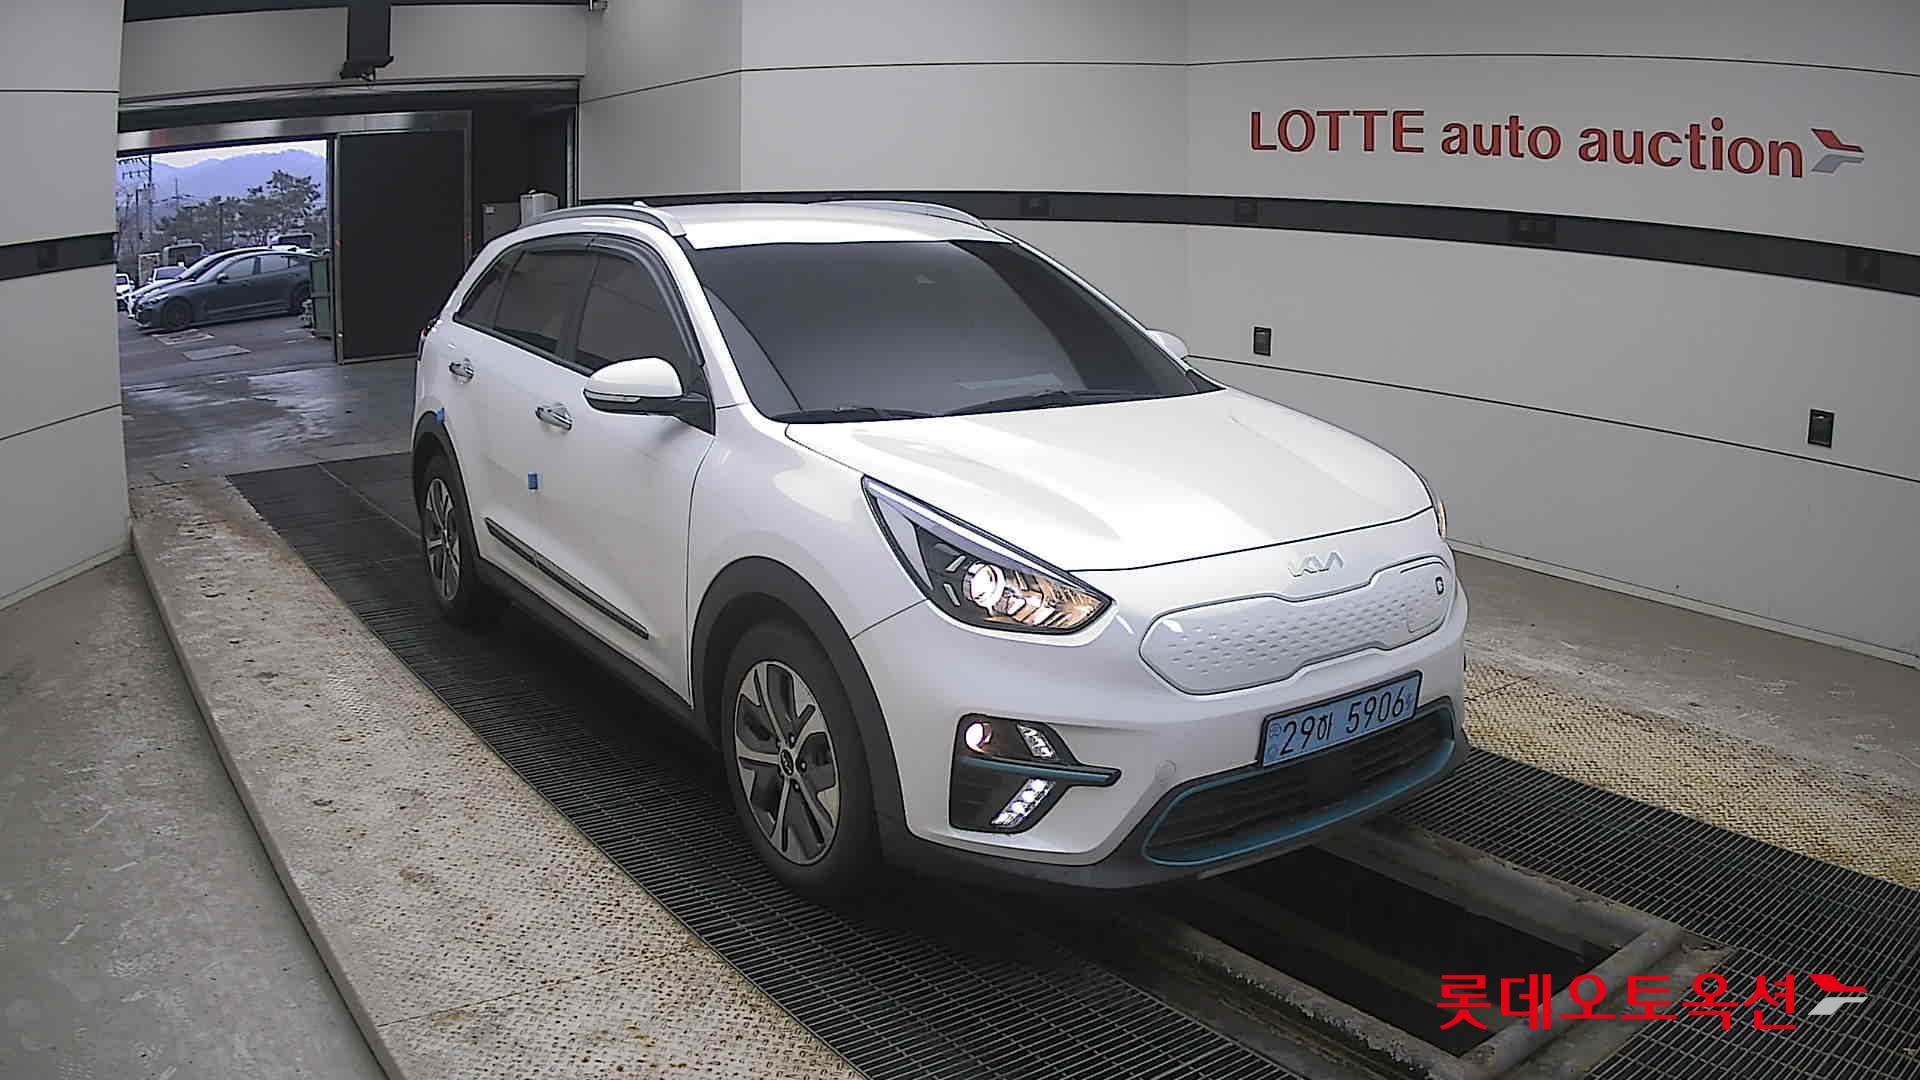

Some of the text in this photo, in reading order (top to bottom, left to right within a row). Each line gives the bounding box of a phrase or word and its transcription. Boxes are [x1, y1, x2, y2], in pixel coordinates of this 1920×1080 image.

[1251, 110, 1804, 178] LOTTE auto auction
[1346, 687, 1404, 734] 5906
